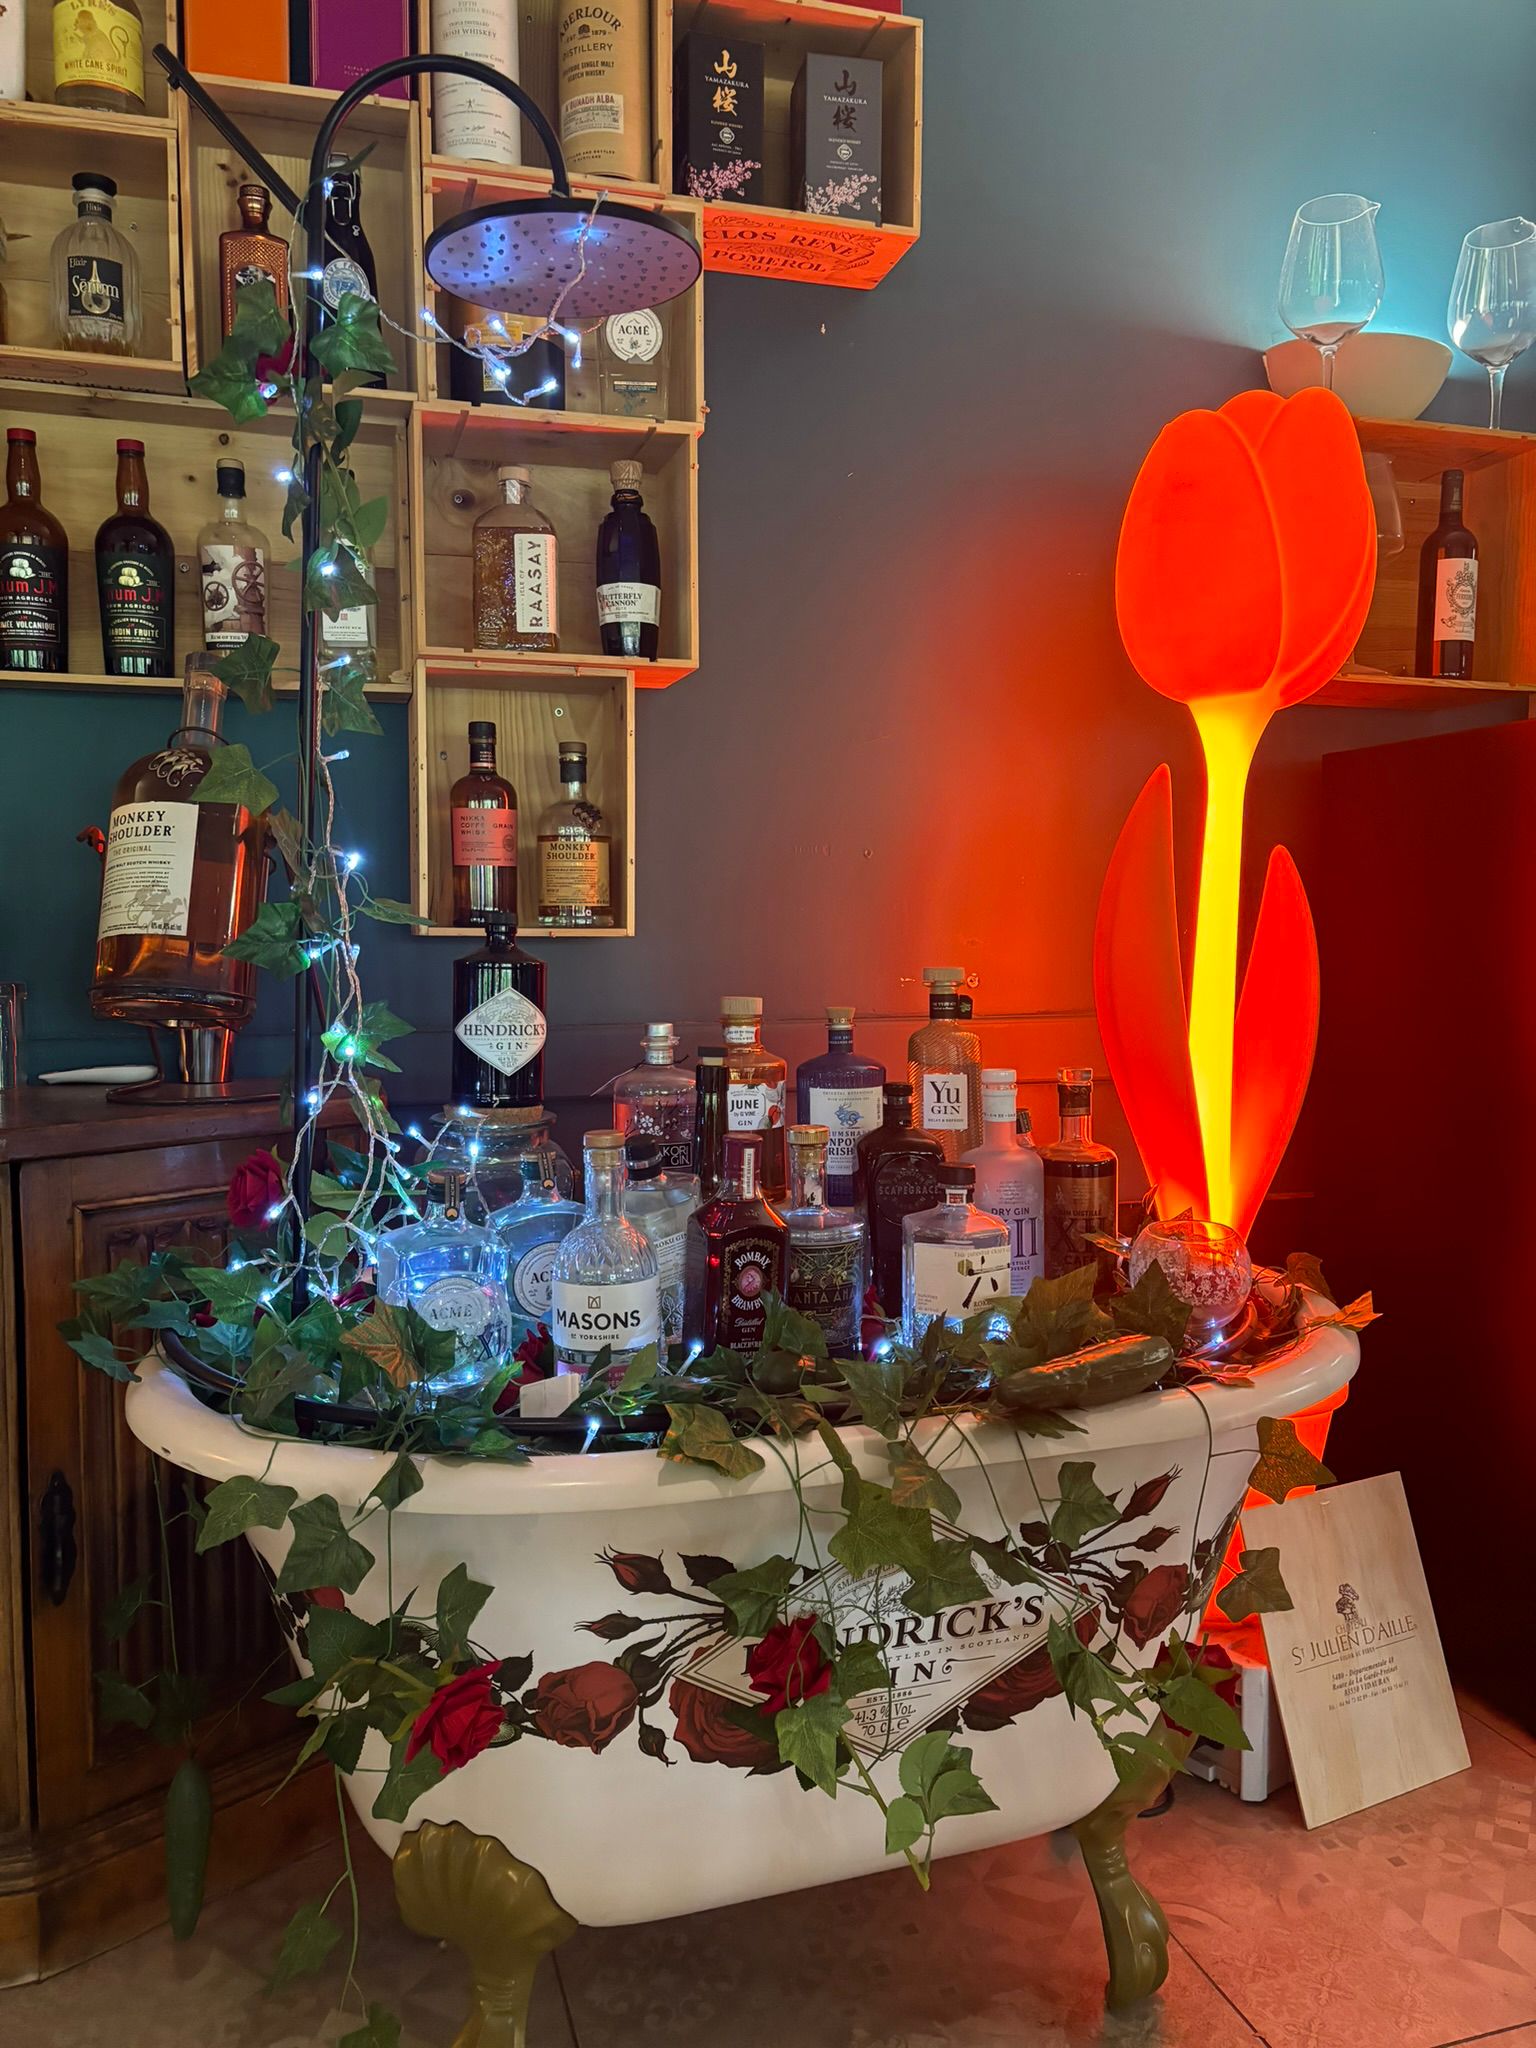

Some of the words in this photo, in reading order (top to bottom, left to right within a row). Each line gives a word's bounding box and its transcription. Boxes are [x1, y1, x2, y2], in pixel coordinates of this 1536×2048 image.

[560, 6, 621, 41] ABERLOUR
[462, 28, 497, 38] WHISKEY
[85, 59, 103, 69] CANE
[106, 63, 127, 77] SPIRIT
[705, 75, 749, 89] YAMAZAKURA
[596, 94, 615, 105] ALBA
[823, 95, 868, 105] YAMAZAKURA
[703, 229, 777, 241] CLOS
[711, 249, 826, 272] POMEROL
[528, 540, 543, 628] RAASAY
[16, 621, 56, 631] VOLCANIQUE
[112, 810, 167, 829] MONKEY
[109, 825, 172, 844] SHOULDER
[122, 845, 153, 855] ORIGINAL
[549, 843, 591, 851] MONKEY
[546, 852, 596, 860] SHOULDER
[463, 1024, 545, 1036] HENDRICK'S
[496, 1042, 523, 1051] GIN
[930, 1081, 962, 1104] Yu
[730, 1099, 760, 1113] JUNE
[931, 1105, 961, 1115] GIN
[828, 1147, 854, 1156] RISH
[671, 1155, 690, 1166] GIN
[879, 1185, 939, 1196] SCAPEGRACE
[991, 1208, 1012, 1216] DRY
[734, 1251, 771, 1268] BOMBAY
[556, 1309, 641, 1331] MASONS
[937, 1645, 953, 1655] IN
[959, 1633, 1030, 1650] SCOTLAND
[1311, 1629, 1361, 1662] JULIEN
[888, 1660, 936, 1689] IN
[866, 1695, 888, 1704] EST.
[855, 1708, 877, 1724] 41.3
[862, 1723, 877, 1736] 70
